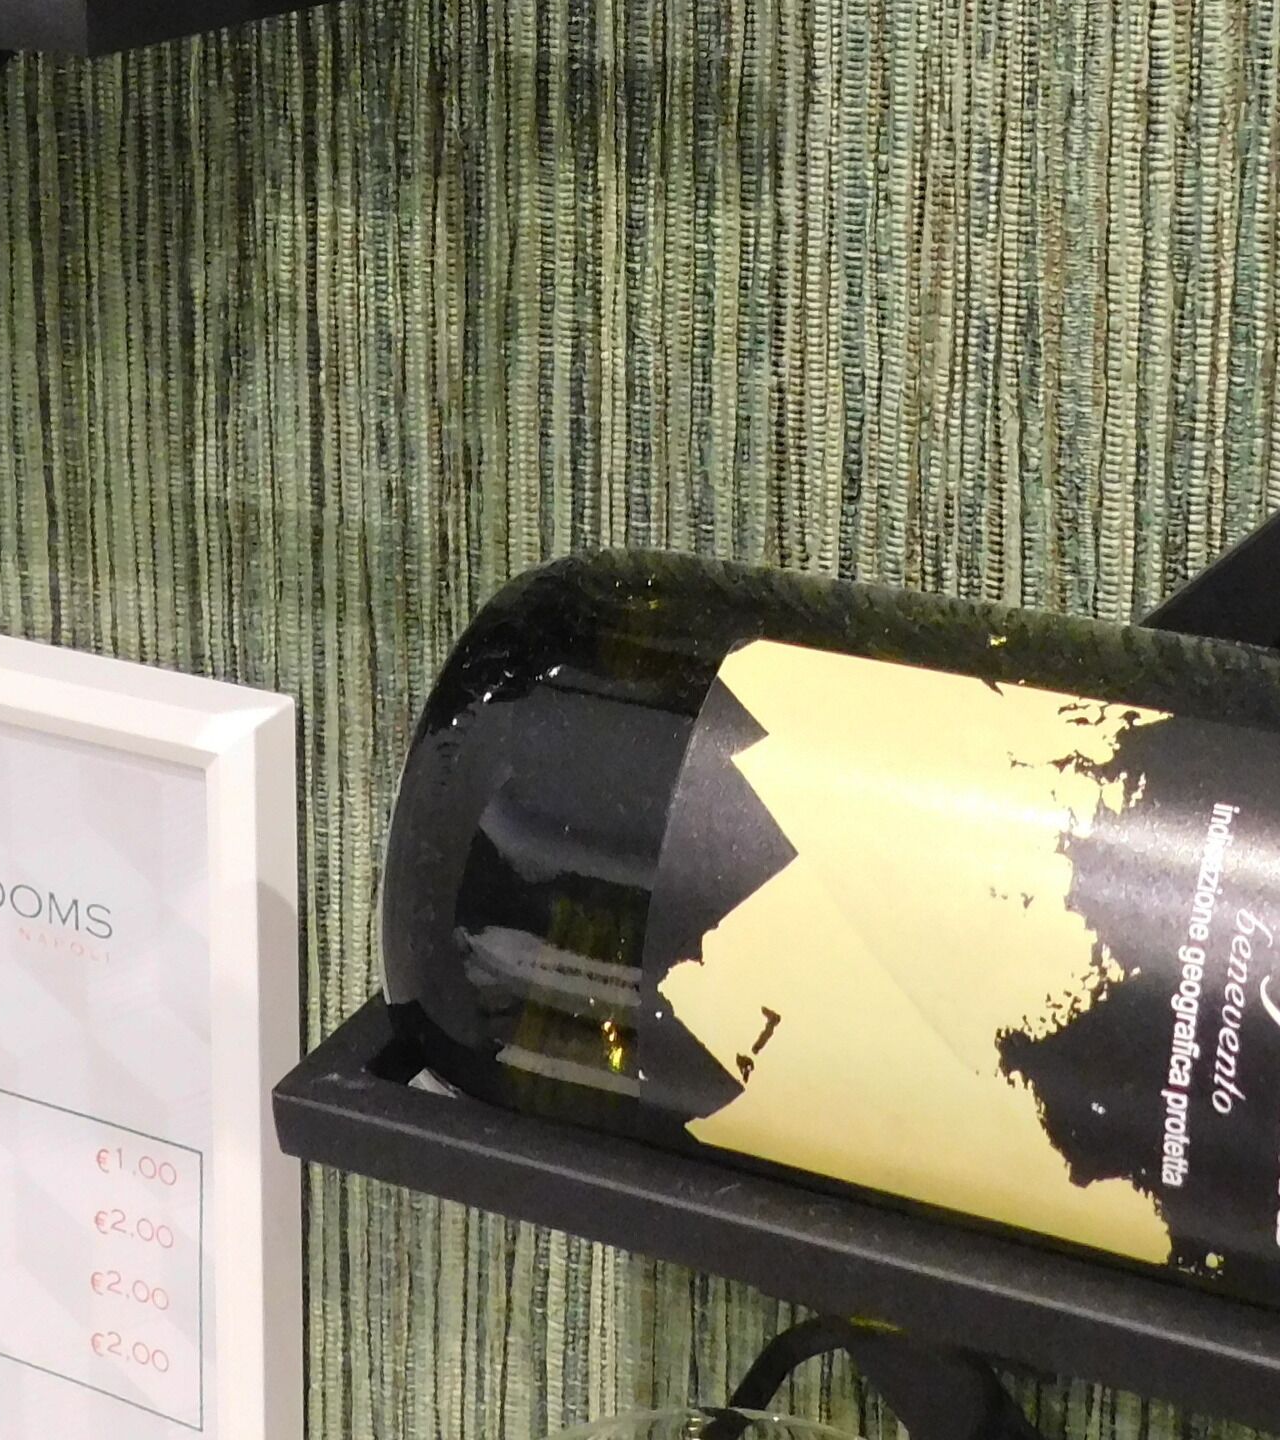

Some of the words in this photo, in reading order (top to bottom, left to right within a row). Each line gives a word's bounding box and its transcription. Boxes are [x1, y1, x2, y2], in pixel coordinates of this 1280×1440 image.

[1168, 944, 1207, 1090] geografica
[1211, 907, 1273, 1116] benevento
[1160, 1089, 1191, 1187] protetta
[95, 1147, 177, 1187] €1.00
[93, 1208, 174, 1249] €2.00
[90, 1269, 170, 1311] €2.00
[90, 1330, 170, 1373] €2.00
